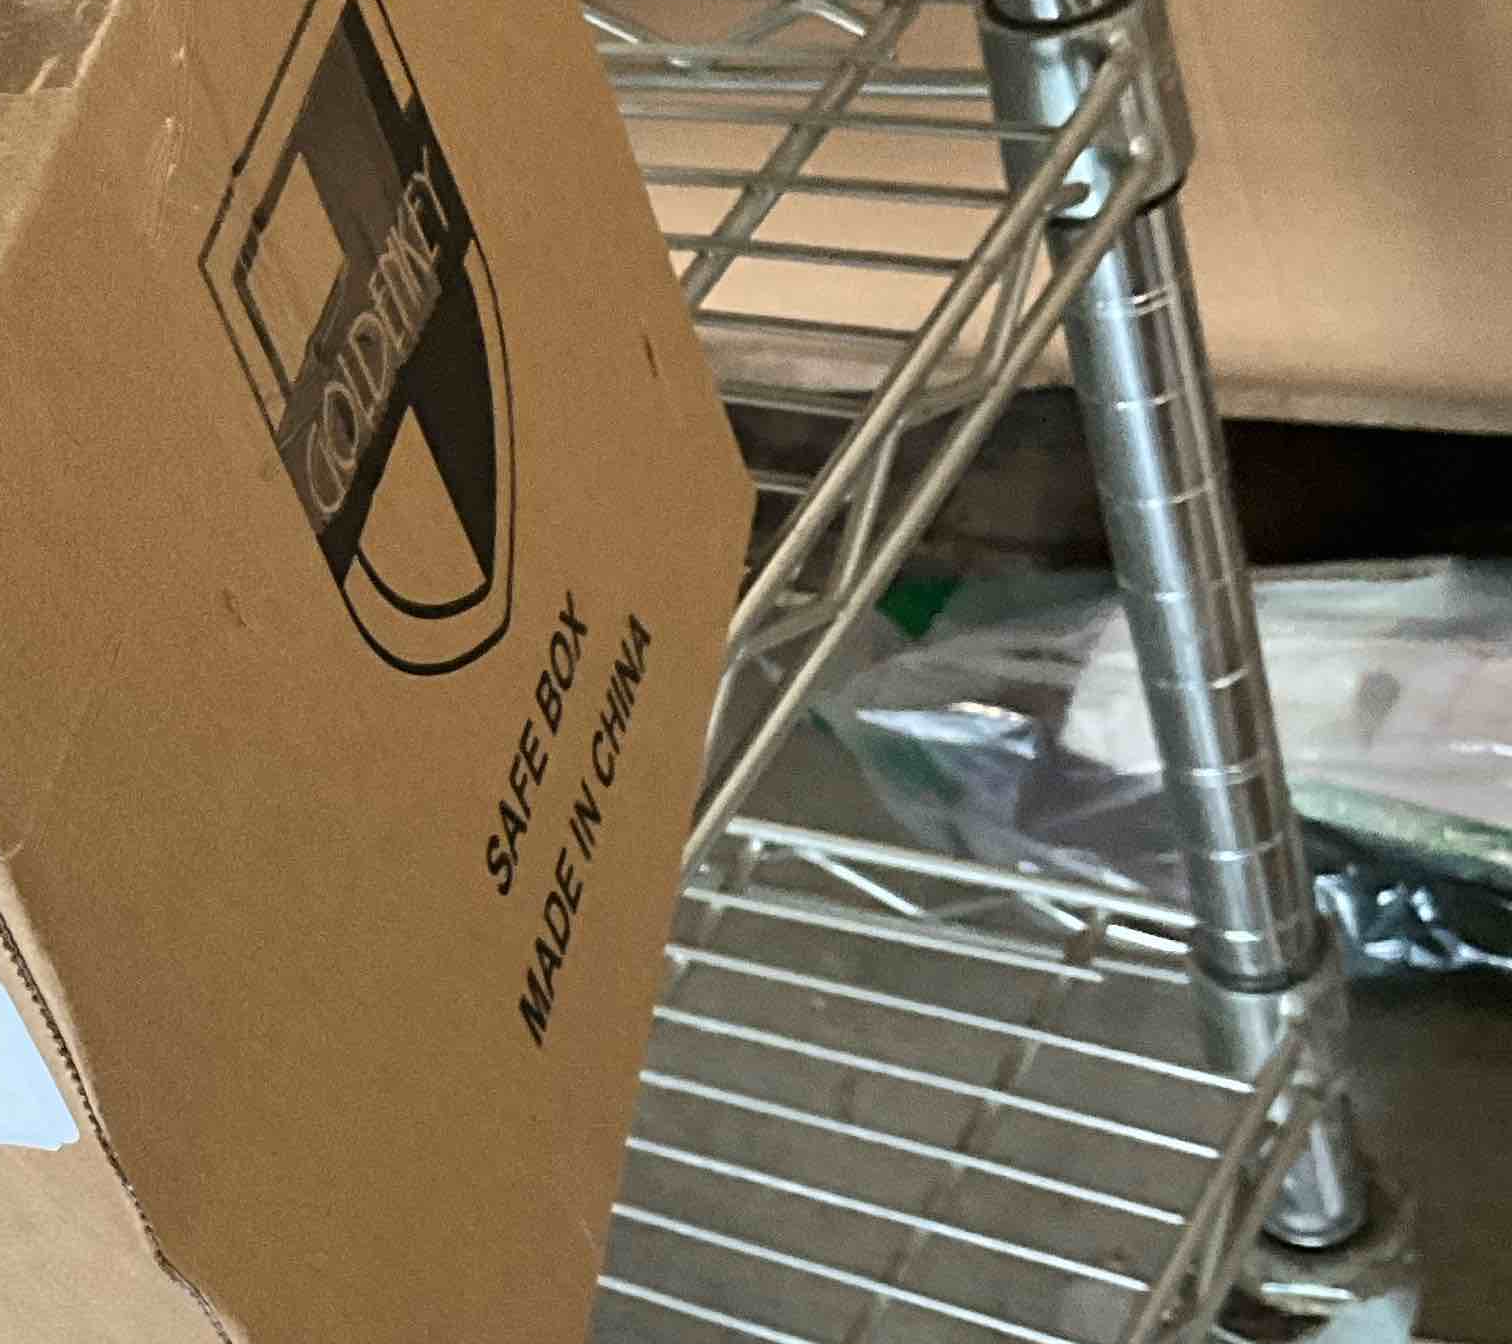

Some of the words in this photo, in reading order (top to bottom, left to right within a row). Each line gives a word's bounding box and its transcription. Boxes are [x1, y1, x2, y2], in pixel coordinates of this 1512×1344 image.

[487, 718, 548, 896] SAFE
[535, 590, 588, 736] BOX
[518, 846, 583, 1048] MADE
[569, 776, 602, 861] IN
[590, 612, 652, 788] CHINA
